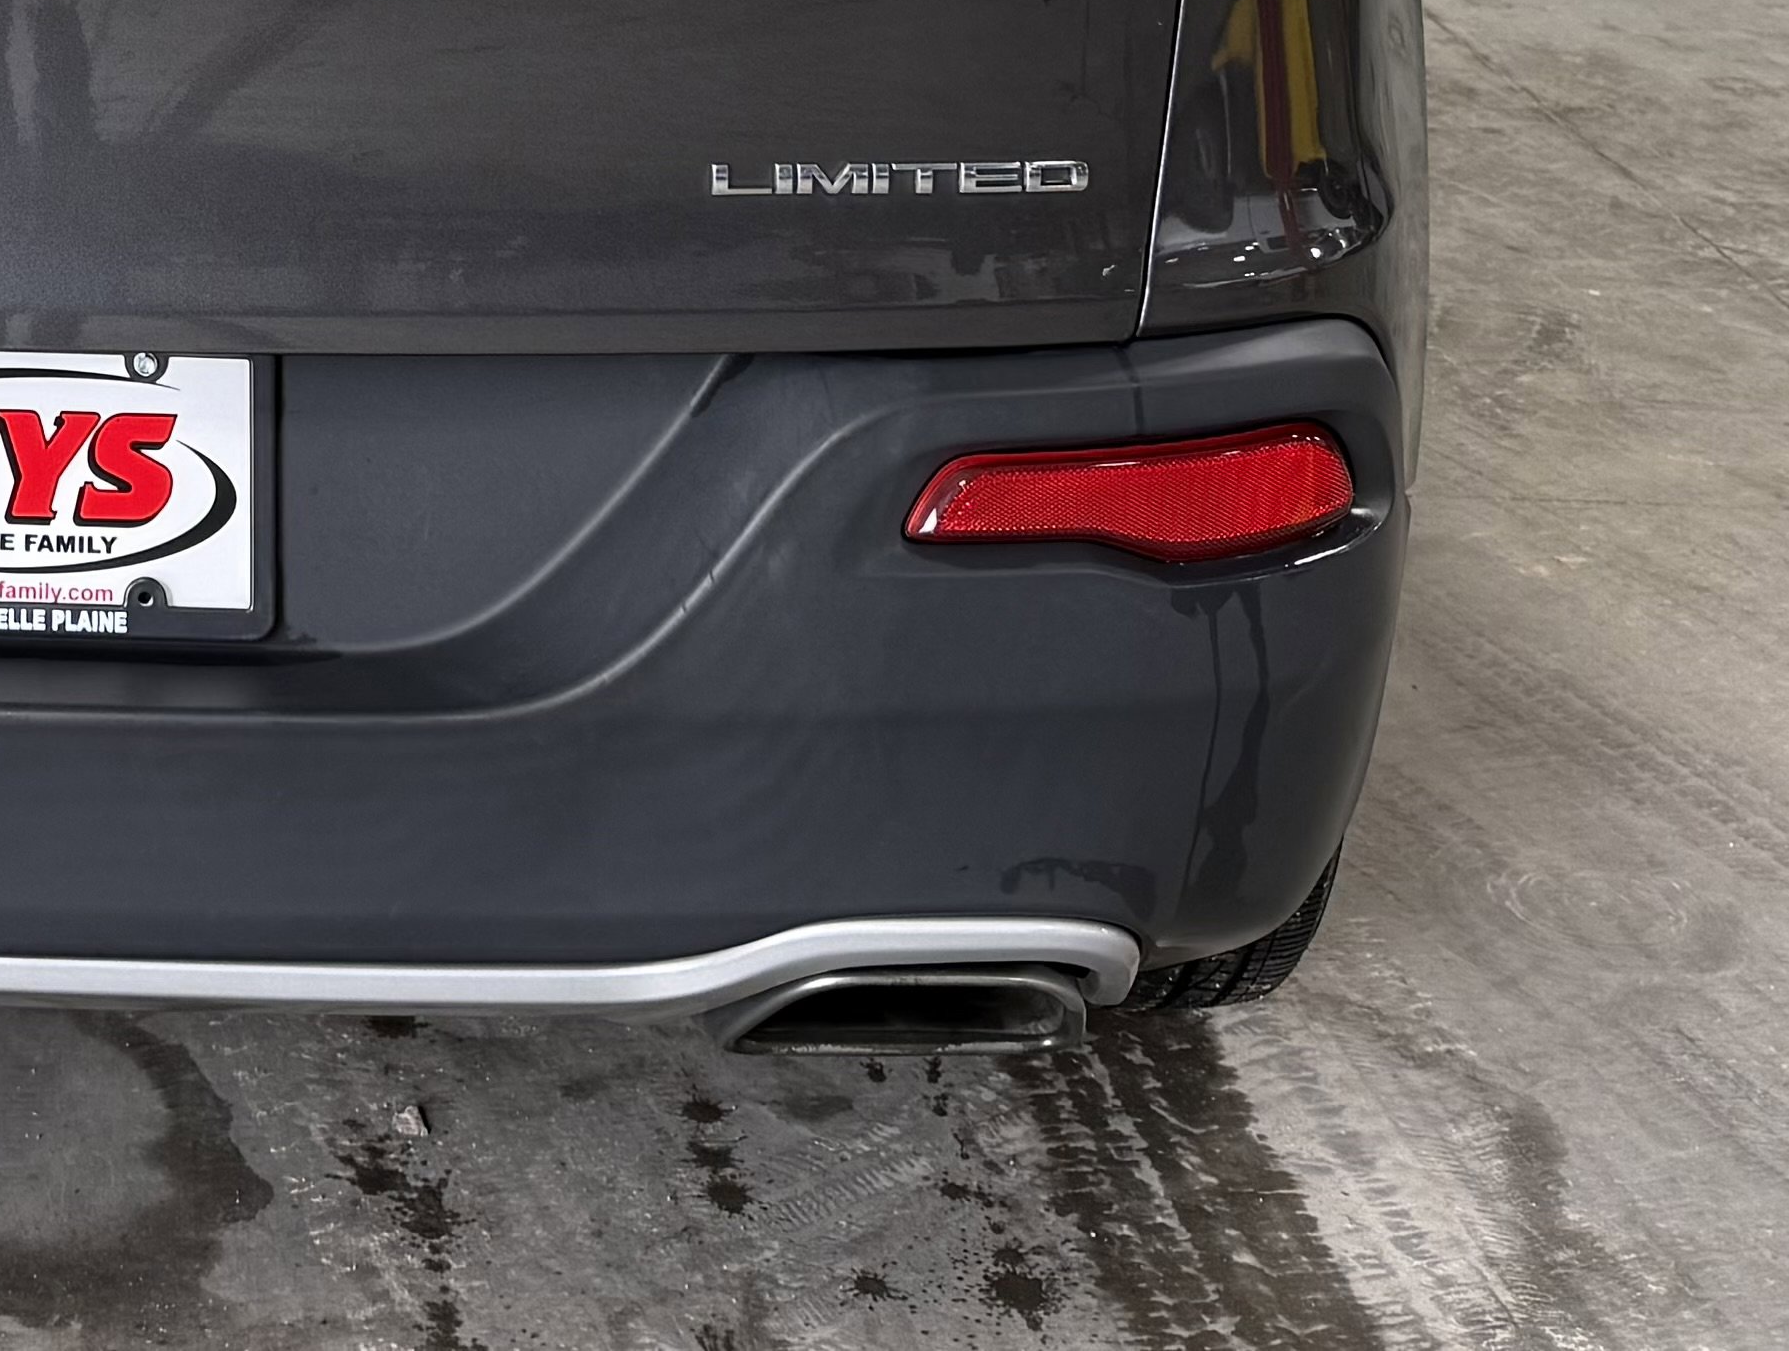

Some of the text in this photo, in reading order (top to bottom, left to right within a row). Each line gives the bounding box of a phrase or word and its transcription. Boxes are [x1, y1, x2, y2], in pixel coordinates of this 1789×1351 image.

[709, 160, 1090, 195] LIMITED
[24, 533, 119, 555] FAMILY
[51, 608, 128, 634] PLAINE
